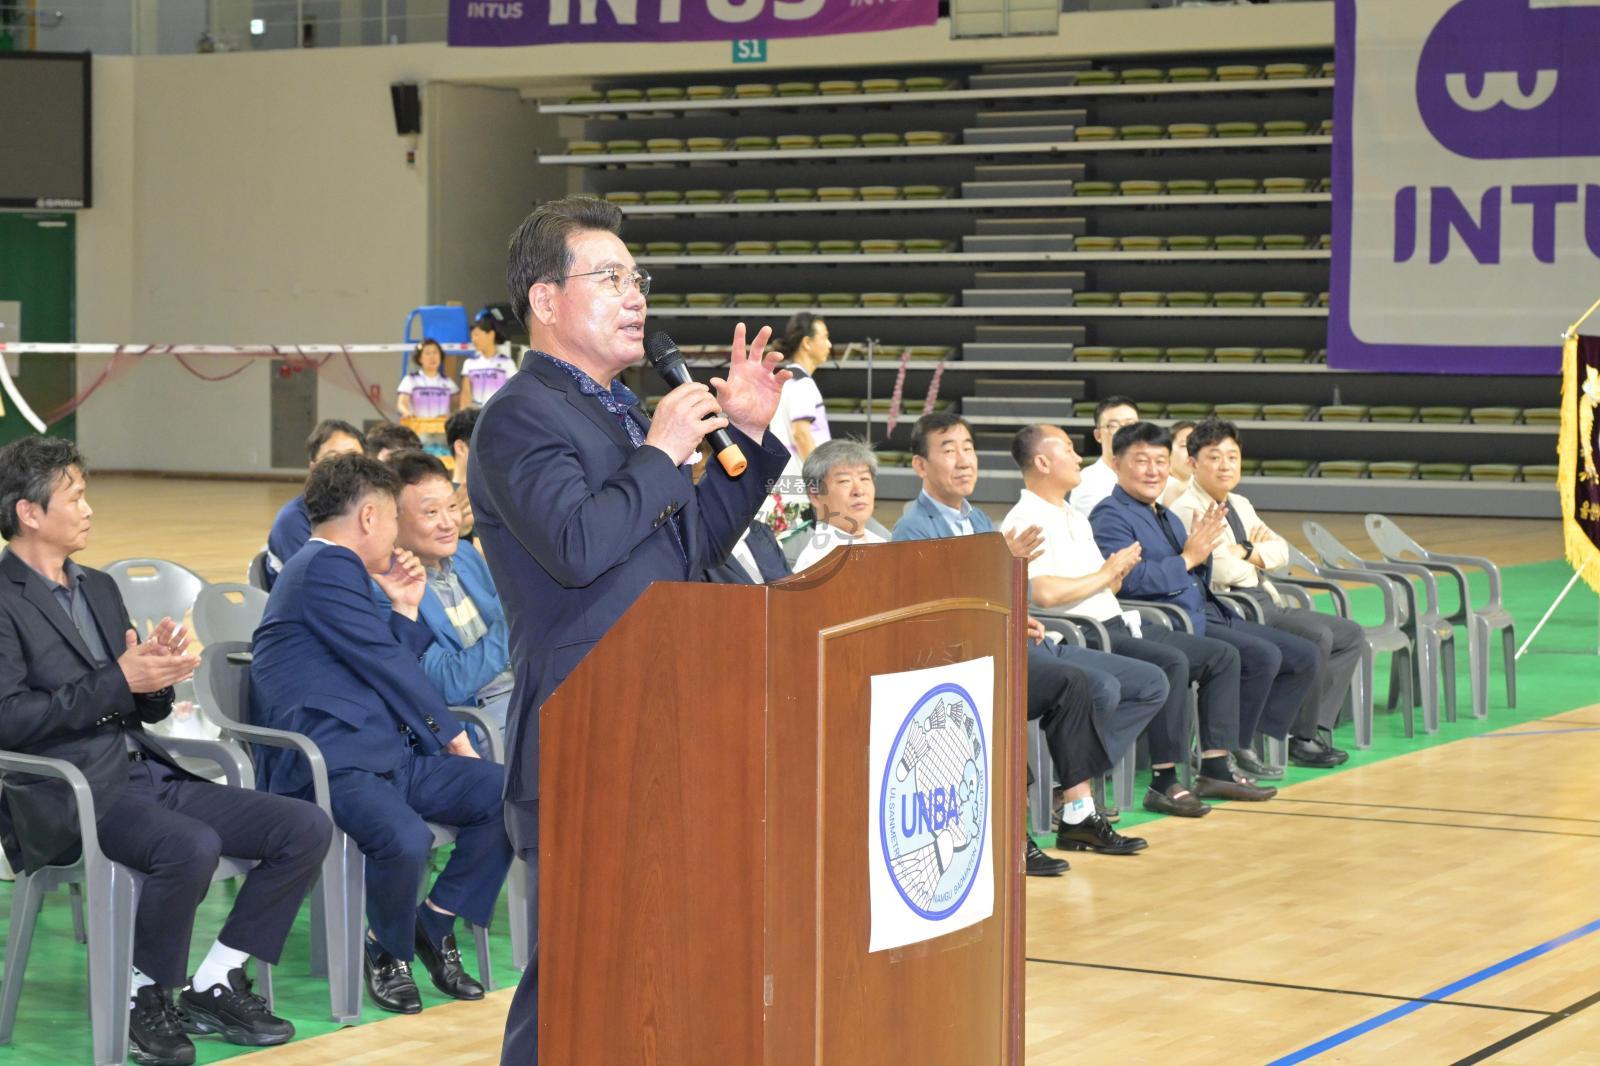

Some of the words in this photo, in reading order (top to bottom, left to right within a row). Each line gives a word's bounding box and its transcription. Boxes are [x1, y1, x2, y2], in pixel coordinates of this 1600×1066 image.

[467, 2, 523, 19] INTUS
[737, 38, 762, 58] S1
[1393, 183, 1600, 265] INT
[901, 783, 960, 839] UNBA
